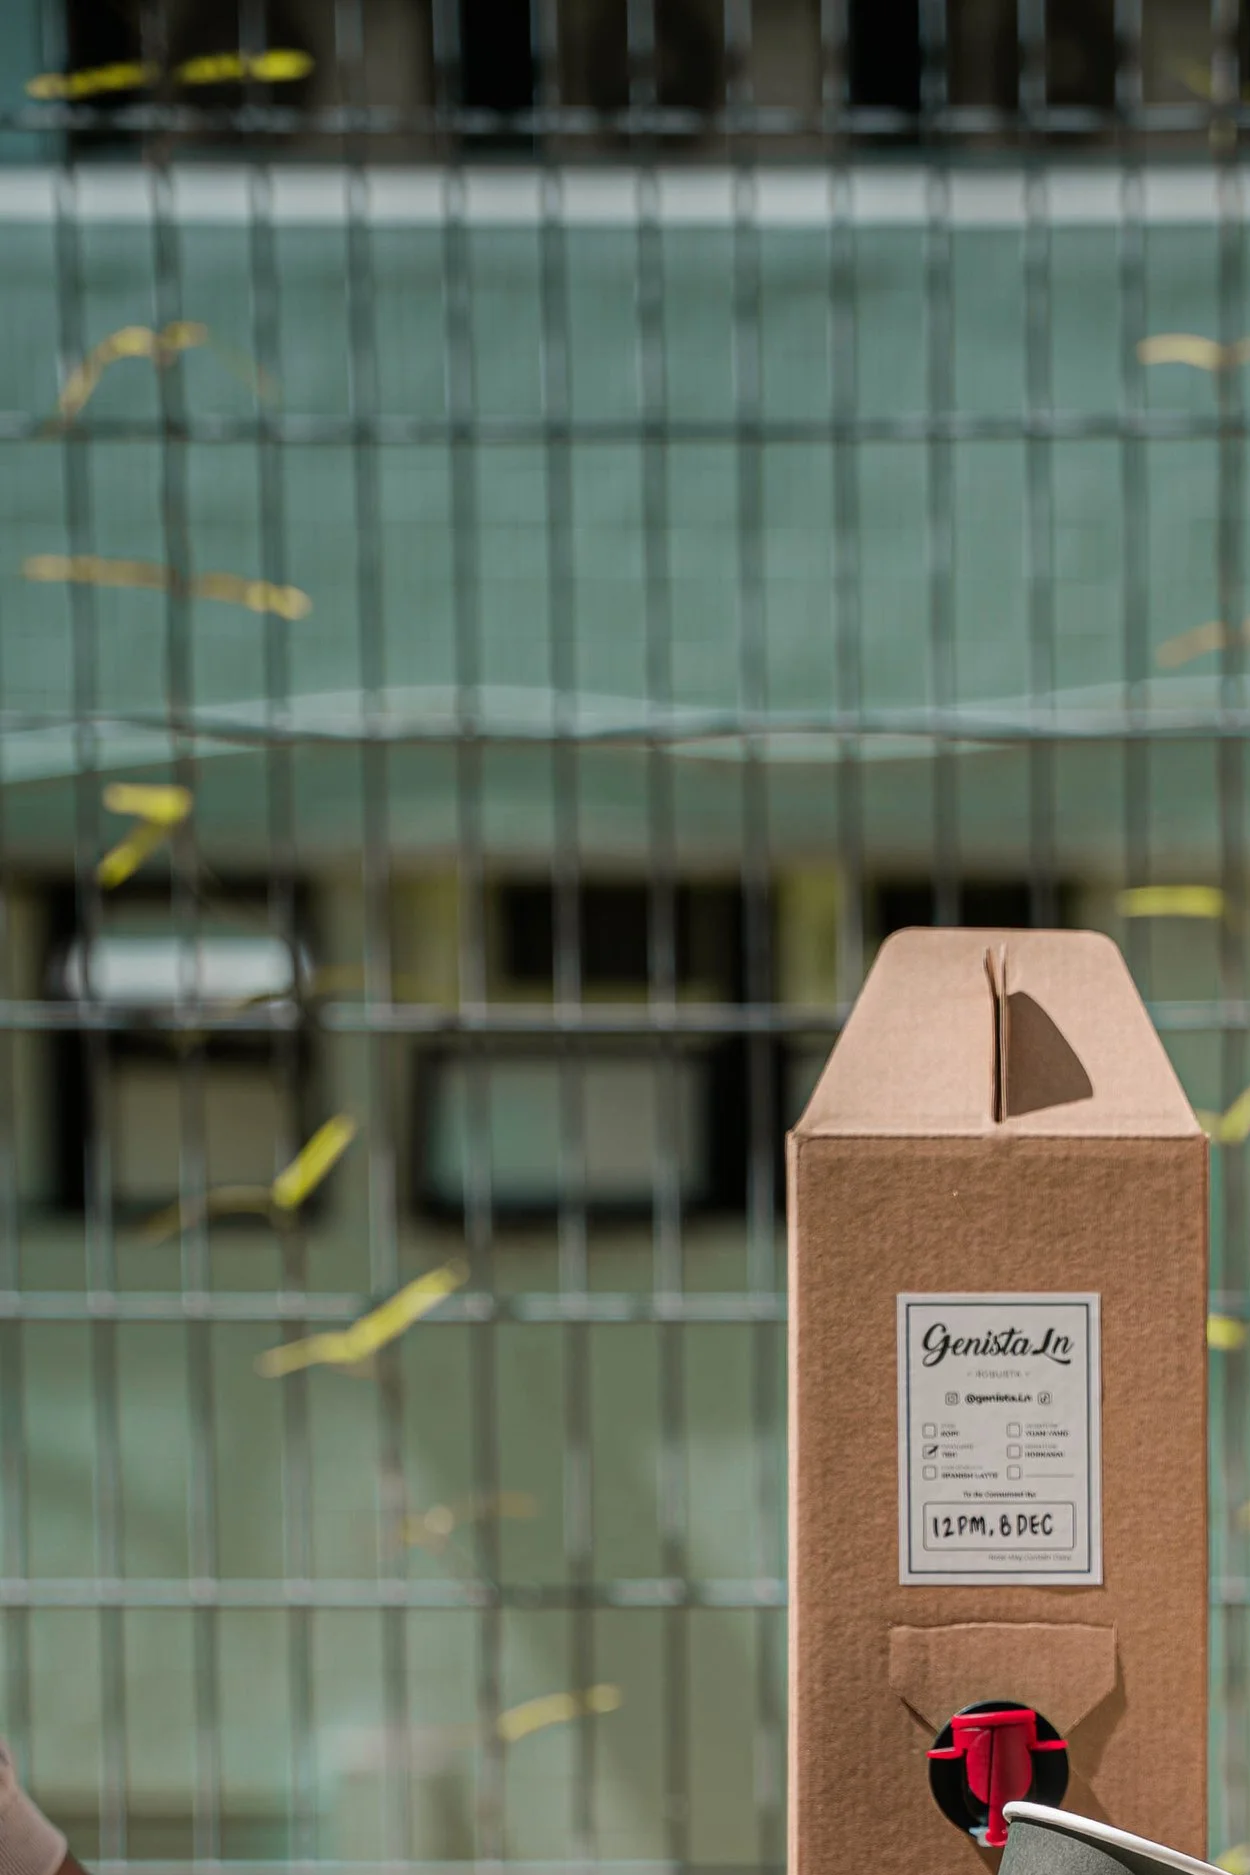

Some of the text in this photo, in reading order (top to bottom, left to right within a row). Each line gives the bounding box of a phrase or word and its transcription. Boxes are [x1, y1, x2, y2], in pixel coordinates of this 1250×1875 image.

[922, 1323, 1074, 1367] Genista Ln
[1016, 1513, 1053, 1536] DEC
